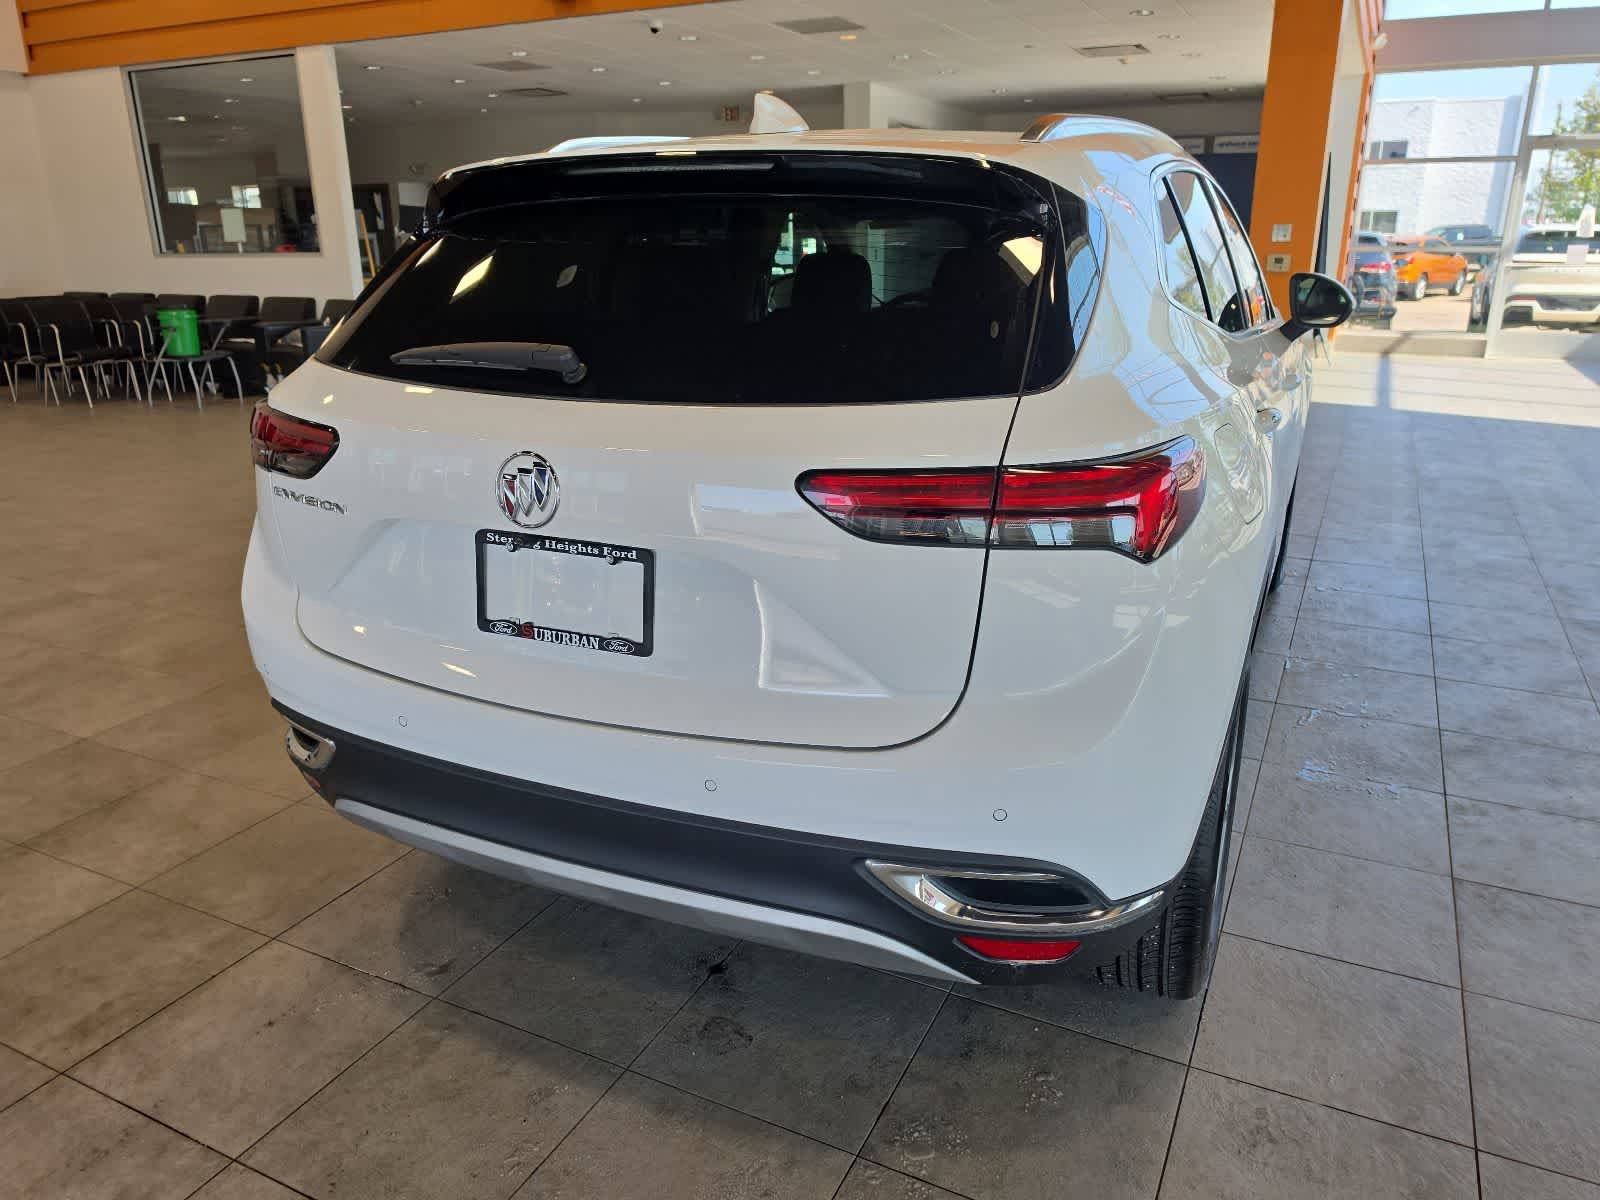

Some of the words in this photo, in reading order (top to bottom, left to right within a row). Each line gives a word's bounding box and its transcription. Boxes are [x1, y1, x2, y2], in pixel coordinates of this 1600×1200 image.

[273, 486, 348, 515] ENVISION
[545, 539, 600, 555] Heights
[603, 546, 637, 560] Ford
[494, 622, 513, 634] Ford
[521, 624, 600, 650] SUBURBAN
[608, 641, 629, 652] Ford
